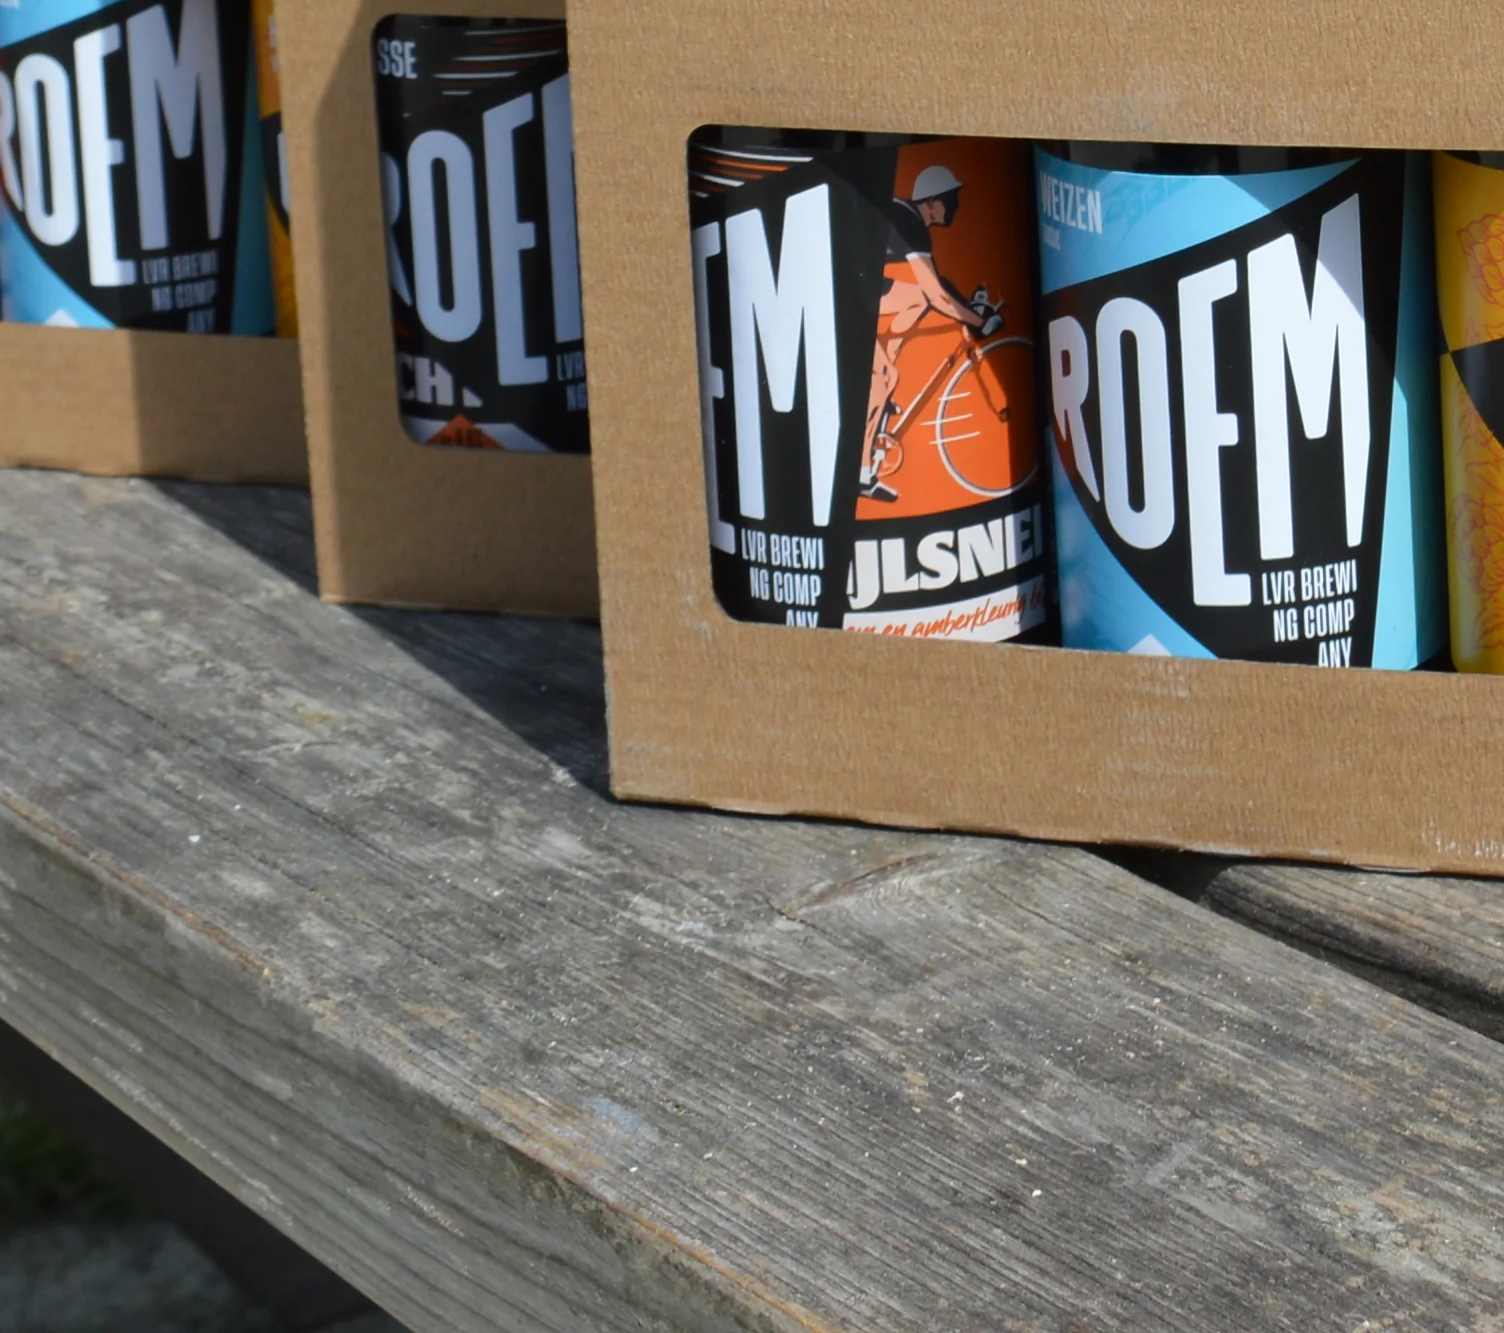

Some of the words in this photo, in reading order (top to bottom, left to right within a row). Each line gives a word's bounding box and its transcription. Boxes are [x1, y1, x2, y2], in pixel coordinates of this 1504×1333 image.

[1039, 170, 1102, 235] WEIZEN
[1048, 192, 1371, 607] ROEM
[741, 527, 766, 565] LVR
[770, 532, 824, 571] BREWI
[749, 566, 770, 602] NG
[773, 570, 821, 607] COMP
[1262, 571, 1296, 606] LVR
[1300, 559, 1358, 602] BREWI
[1273, 608, 1299, 643] NG
[1304, 599, 1355, 639] COMP
[1317, 636, 1353, 669] ANY
